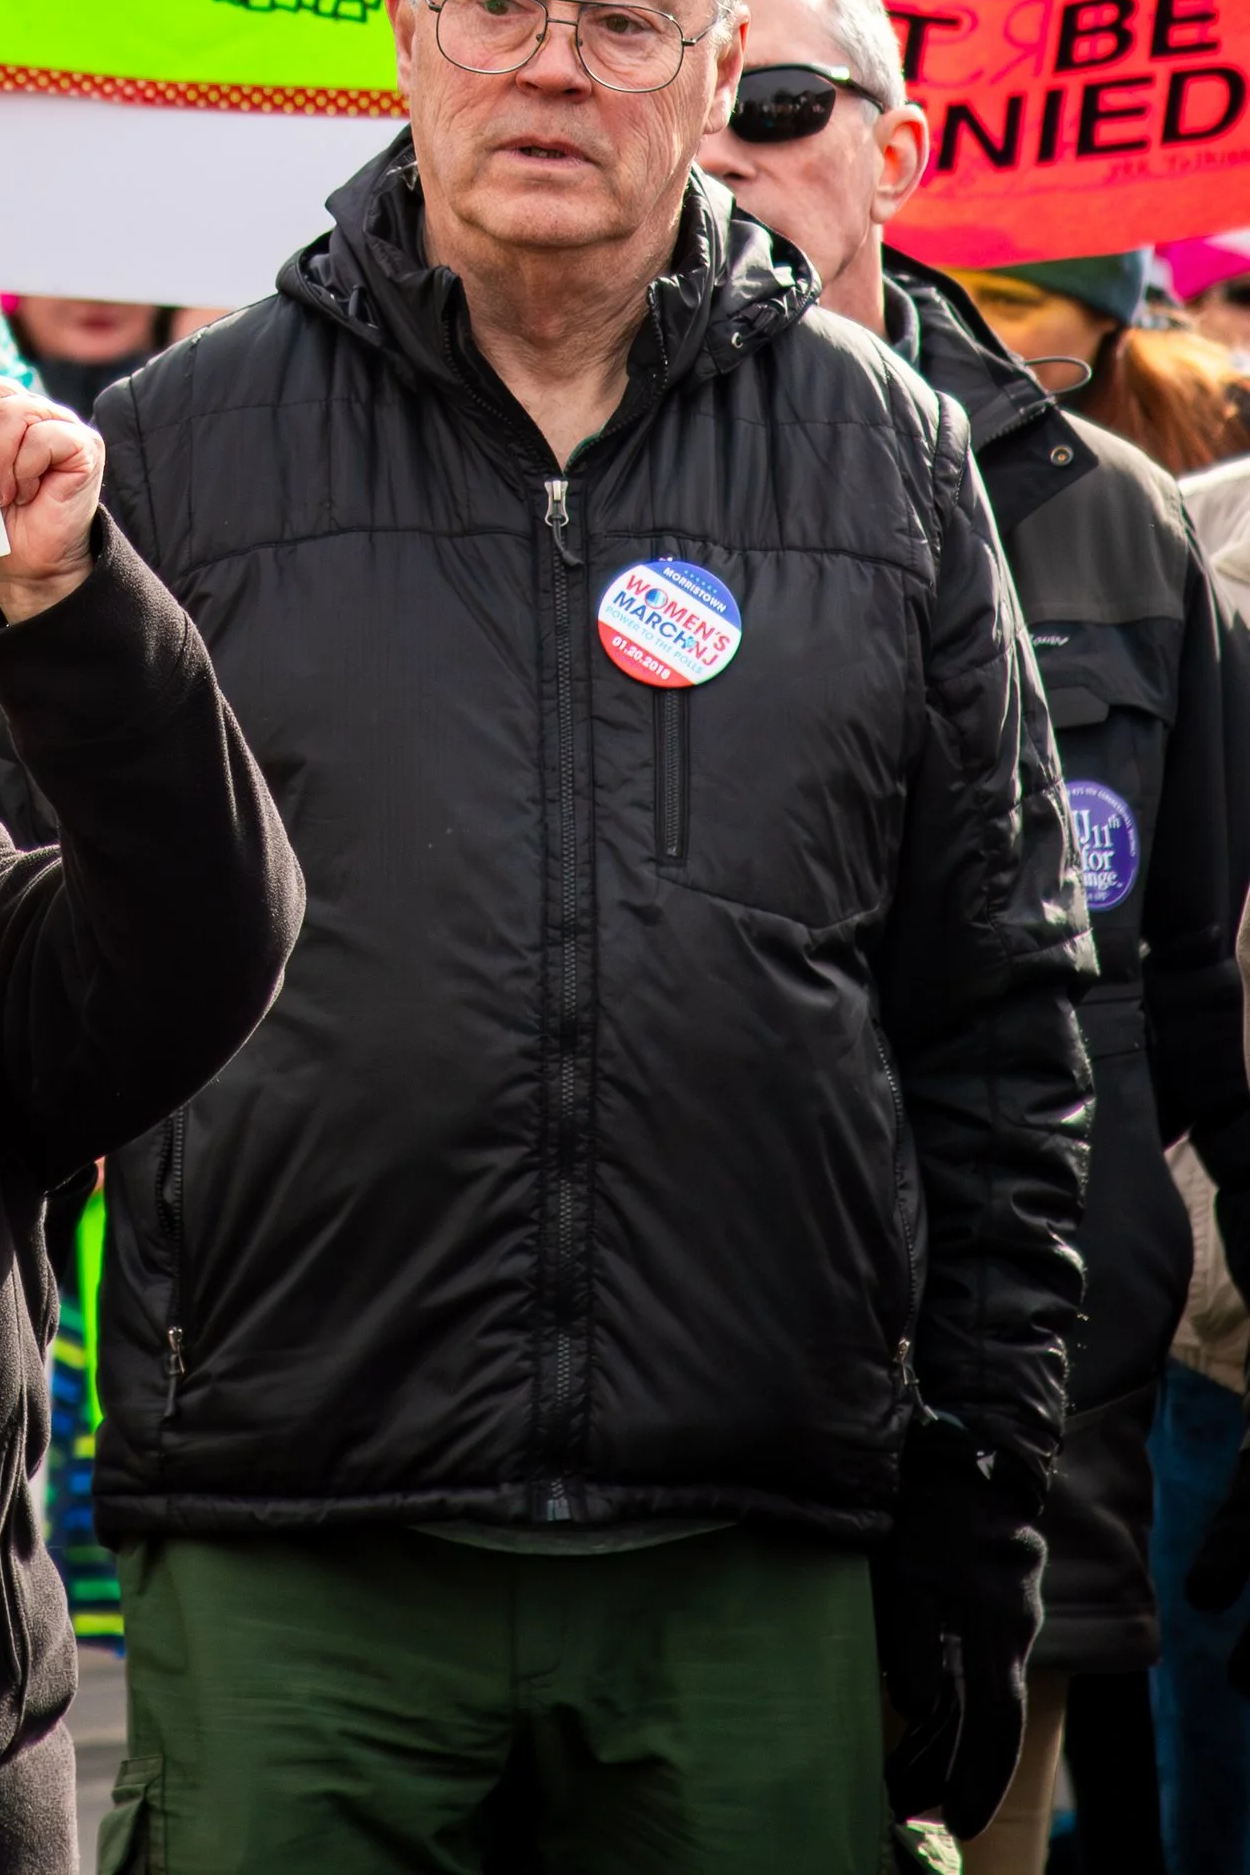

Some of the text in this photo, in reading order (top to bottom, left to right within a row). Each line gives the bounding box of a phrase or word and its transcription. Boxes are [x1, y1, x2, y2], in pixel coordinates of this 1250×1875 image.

[905, 66, 1246, 172] NIED
[612, 590, 688, 650] MARCH
[625, 574, 731, 653] WOMEN'S
[662, 566, 727, 614] MORRISTOWN
[605, 605, 704, 675] POWER TO THE POLLS
